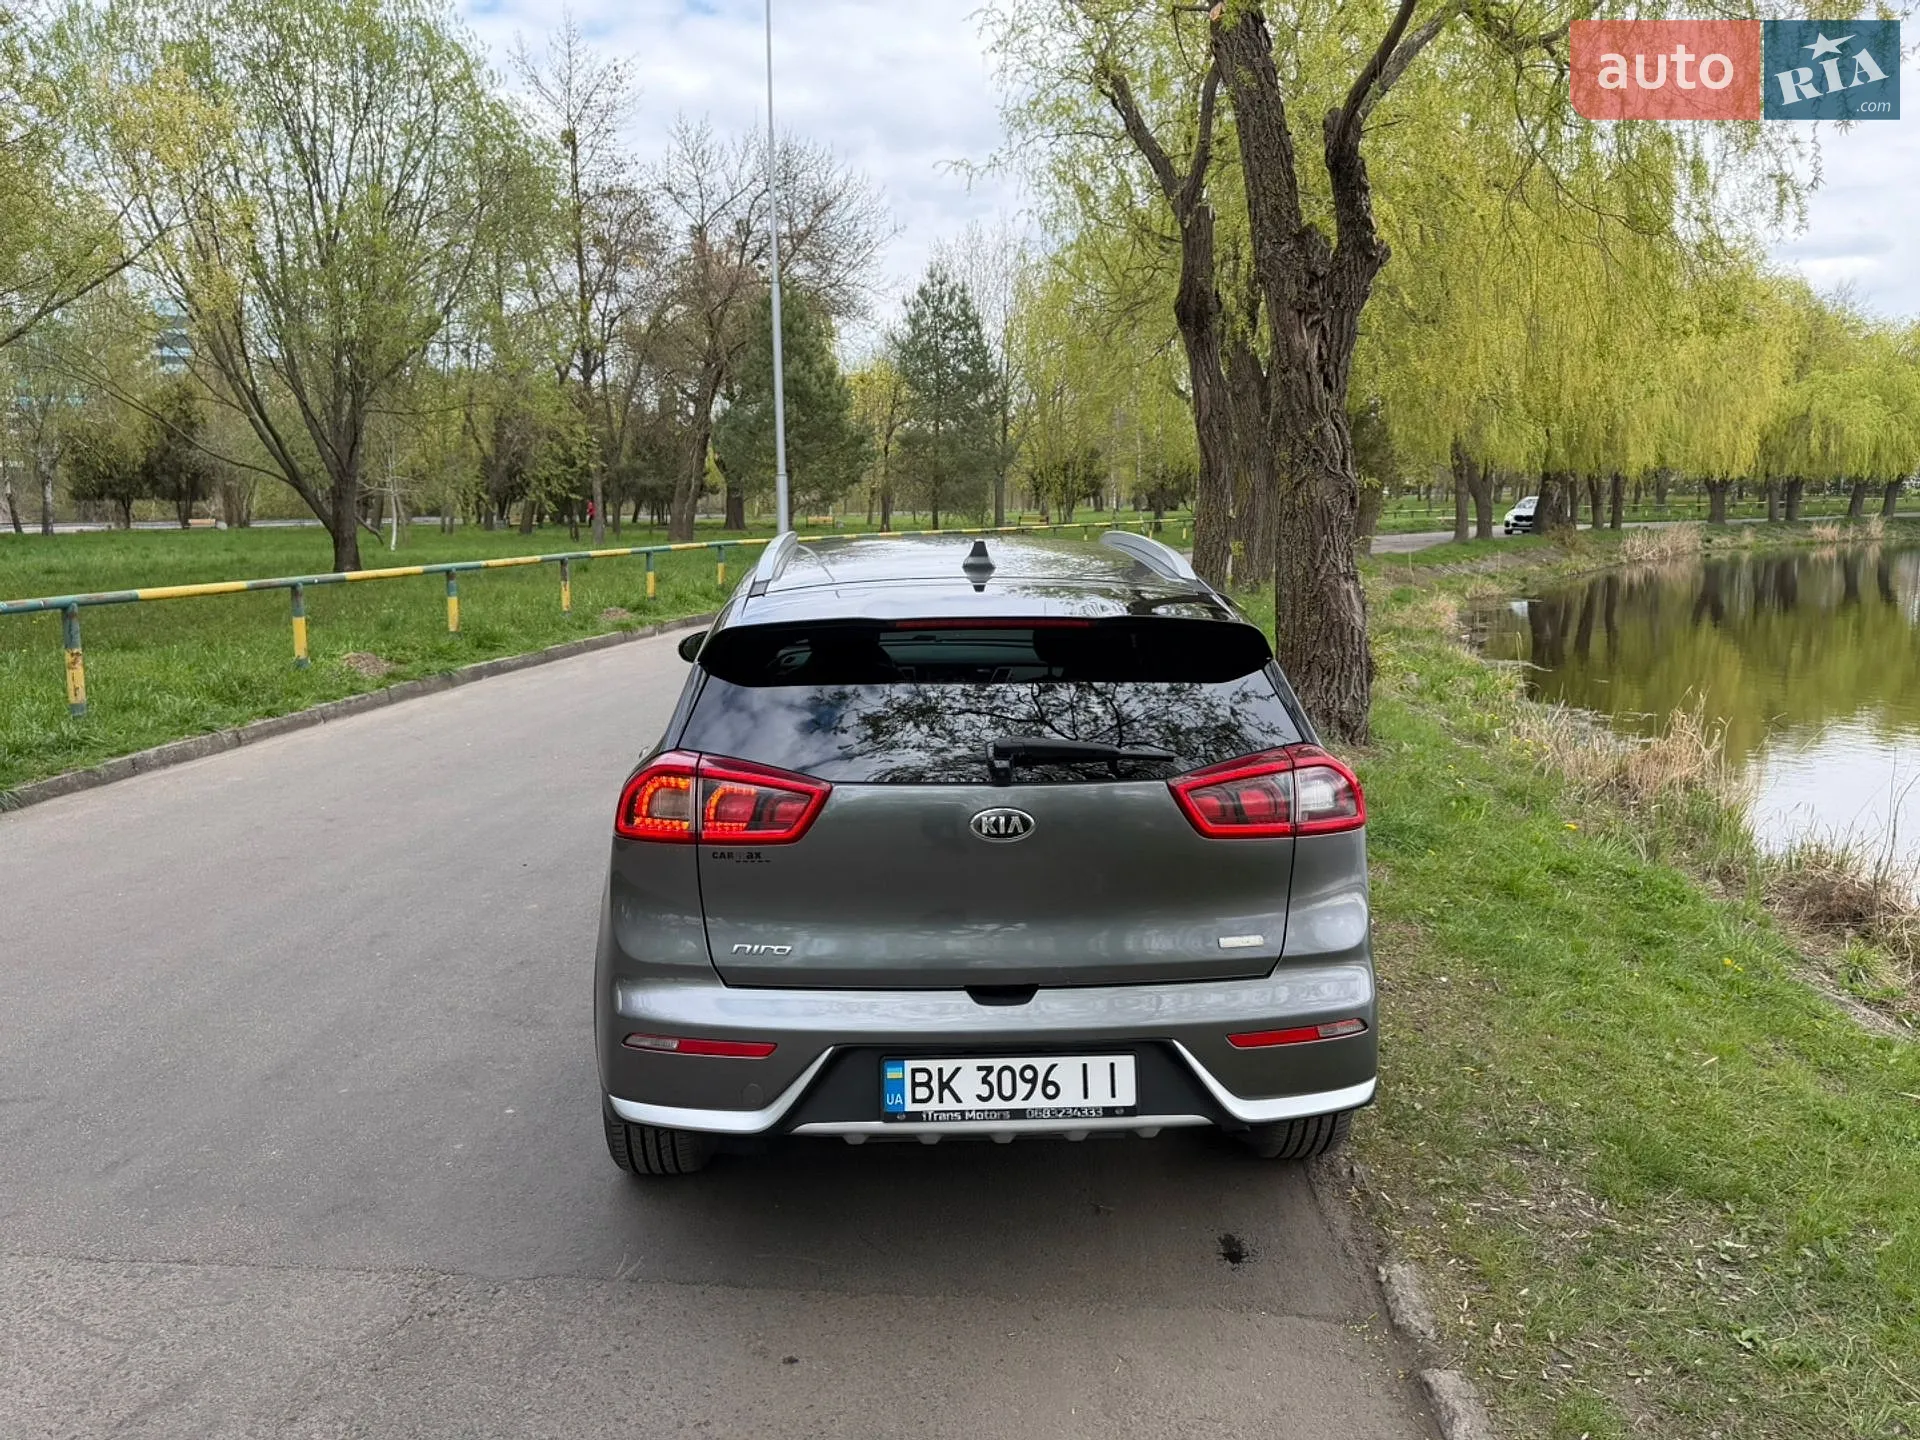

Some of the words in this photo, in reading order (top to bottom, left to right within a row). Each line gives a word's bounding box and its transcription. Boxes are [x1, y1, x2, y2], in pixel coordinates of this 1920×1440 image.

[981, 816, 1024, 834] KIA
[731, 944, 793, 955] niro
[910, 1066, 963, 1104] BK
[975, 1063, 1061, 1103] 3096
[886, 1093, 903, 1105] UA
